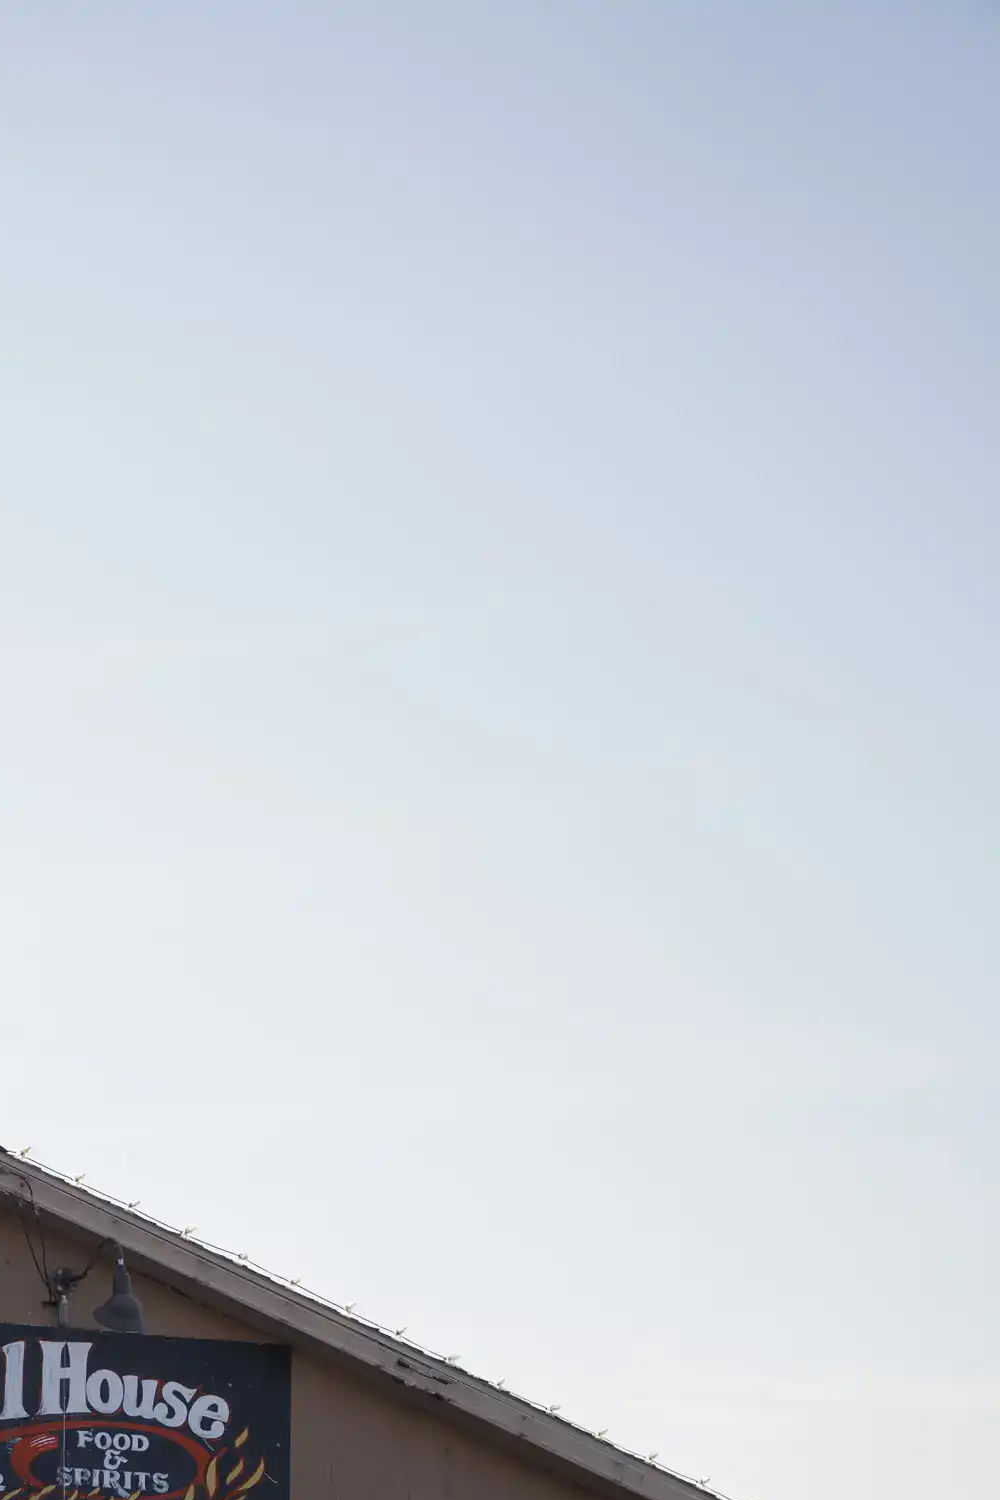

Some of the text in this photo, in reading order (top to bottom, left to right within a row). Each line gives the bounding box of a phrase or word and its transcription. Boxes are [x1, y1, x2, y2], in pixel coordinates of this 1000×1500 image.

[39, 1341, 230, 1439] House
[77, 1430, 149, 1451] FOOD
[103, 1450, 128, 1469] &
[56, 1467, 169, 1498] SPIRITS
